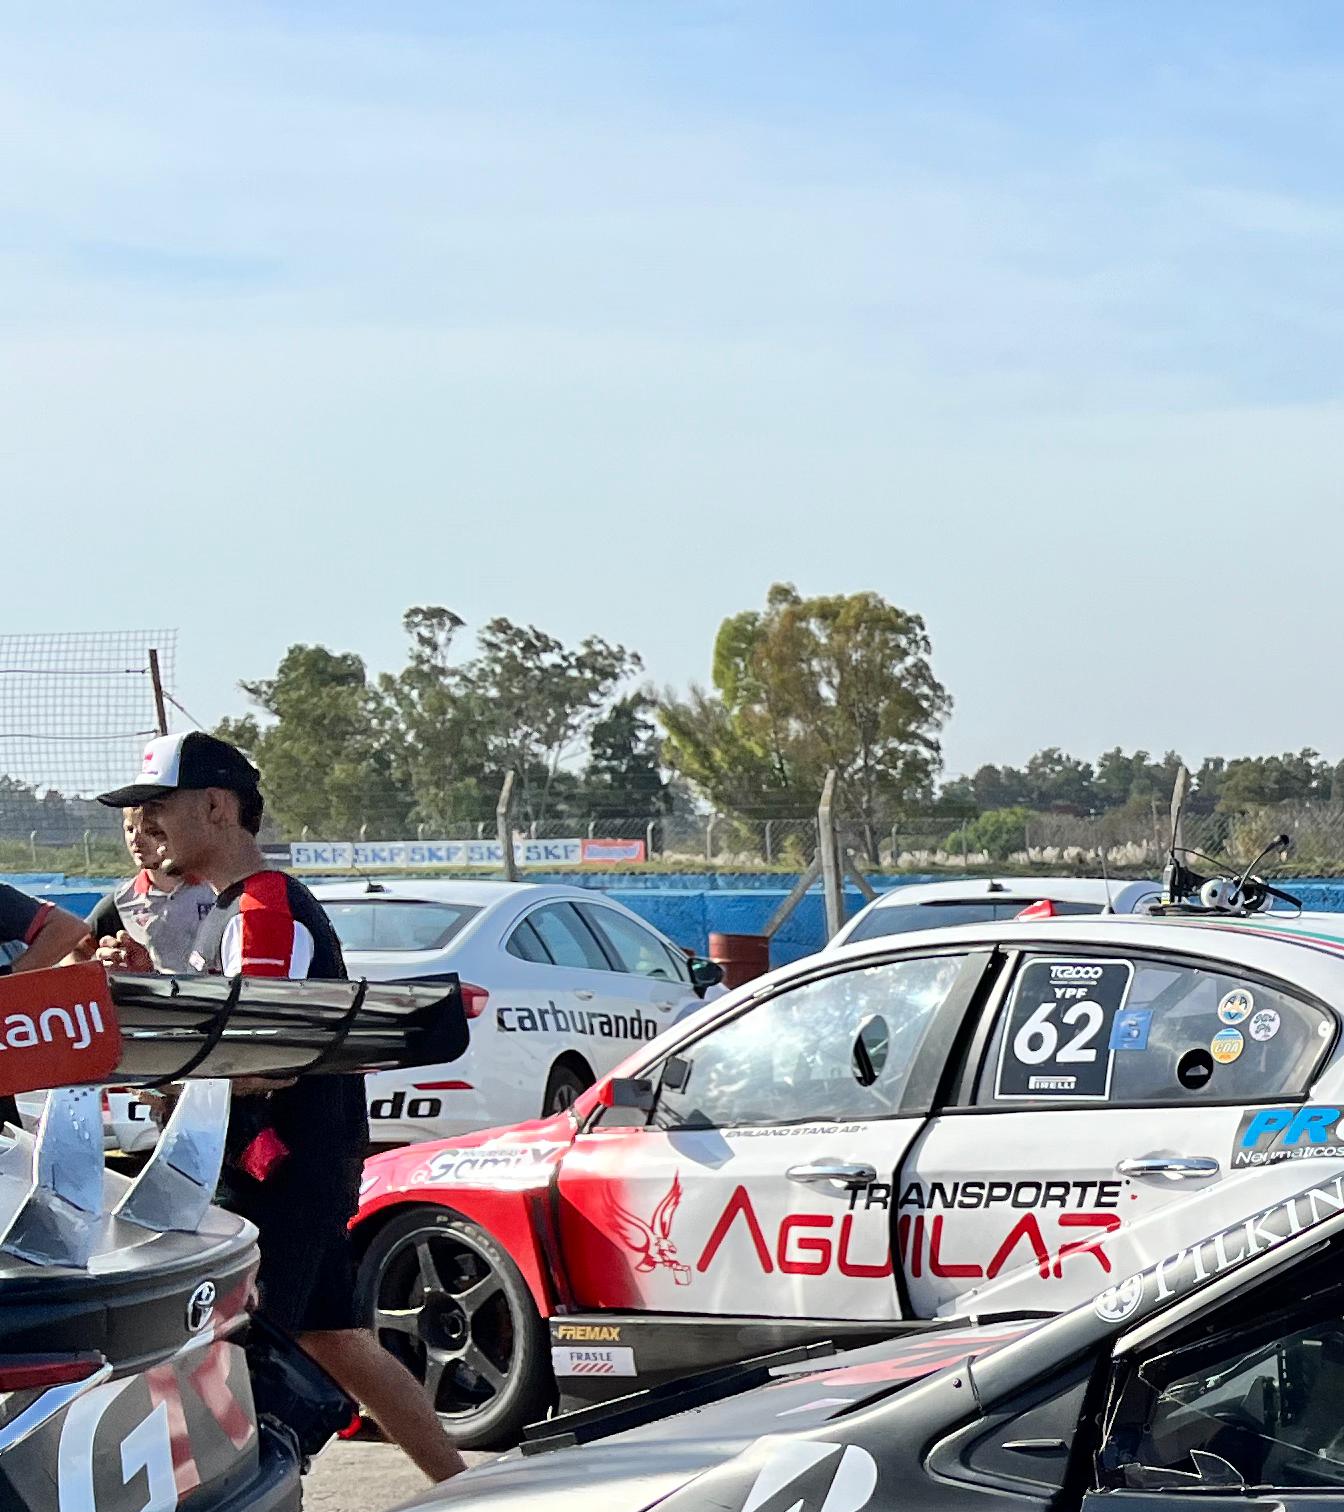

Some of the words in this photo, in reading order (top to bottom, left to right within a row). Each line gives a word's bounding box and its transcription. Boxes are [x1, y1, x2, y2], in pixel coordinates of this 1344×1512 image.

[354, 847, 404, 863] SKF
[409, 846, 462, 863] SKF
[525, 845, 579, 861] SKF
[1050, 966, 1104, 979] TC2000
[1054, 987, 1089, 999] YPF
[0, 1000, 105, 1051] anji
[496, 999, 658, 1041] carburando
[1013, 1000, 1105, 1065] 62
[844, 1180, 1123, 1211] TRANSPORTE
[696, 1184, 1122, 1280] AGUILAR
[558, 1325, 621, 1341] FREMAX
